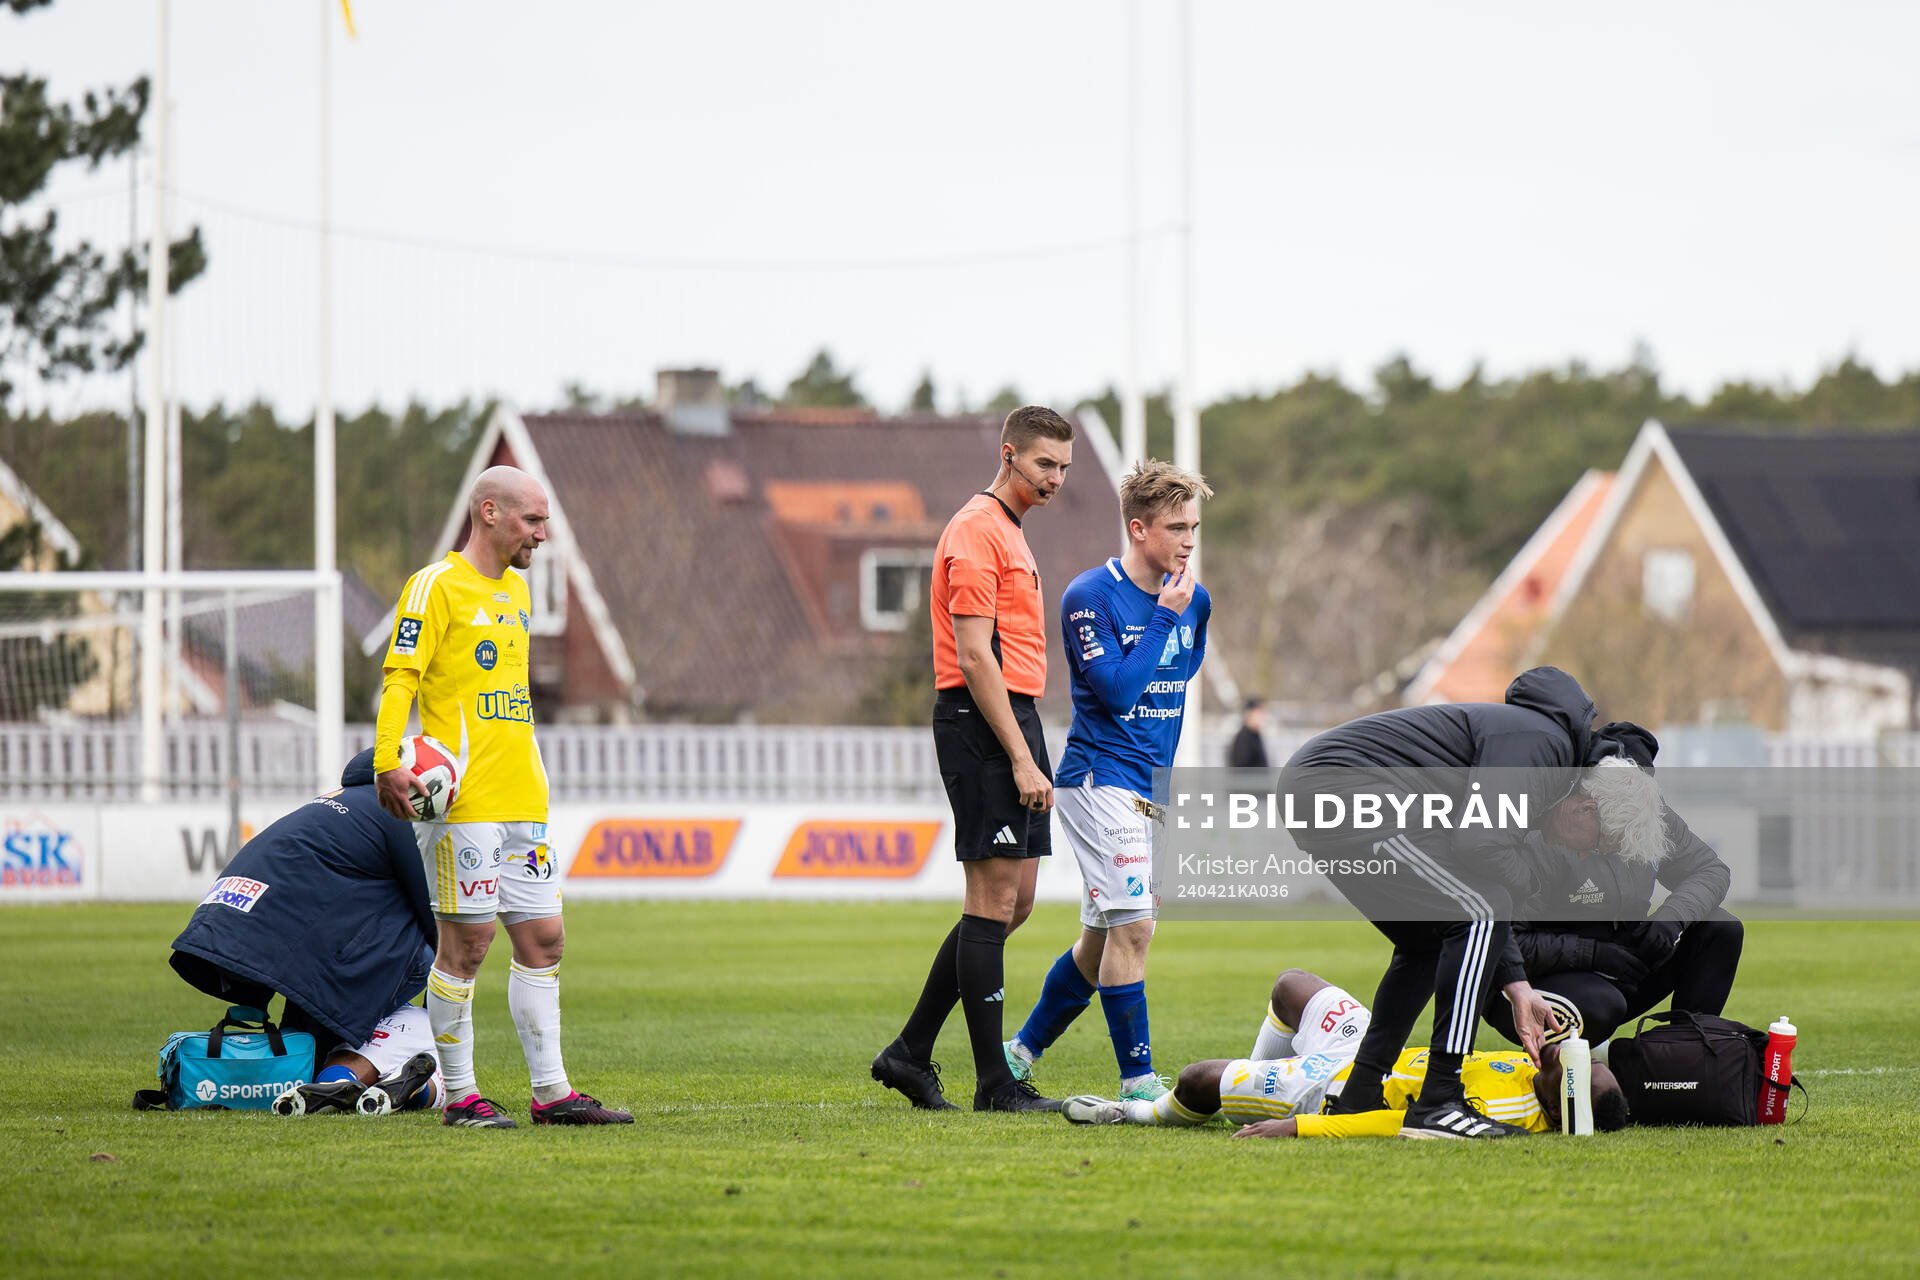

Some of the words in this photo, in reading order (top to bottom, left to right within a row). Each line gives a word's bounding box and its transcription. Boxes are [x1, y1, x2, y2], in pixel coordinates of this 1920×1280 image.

[1070, 608, 1096, 622] BORÅS
[477, 690, 535, 725] Ullar
[4, 832, 71, 869] SK
[594, 827, 713, 867] JONAB
[800, 829, 915, 867] JONAB
[1567, 1066, 1575, 1097] SPORT
[1651, 1081, 1699, 1090] INTERSPORT
